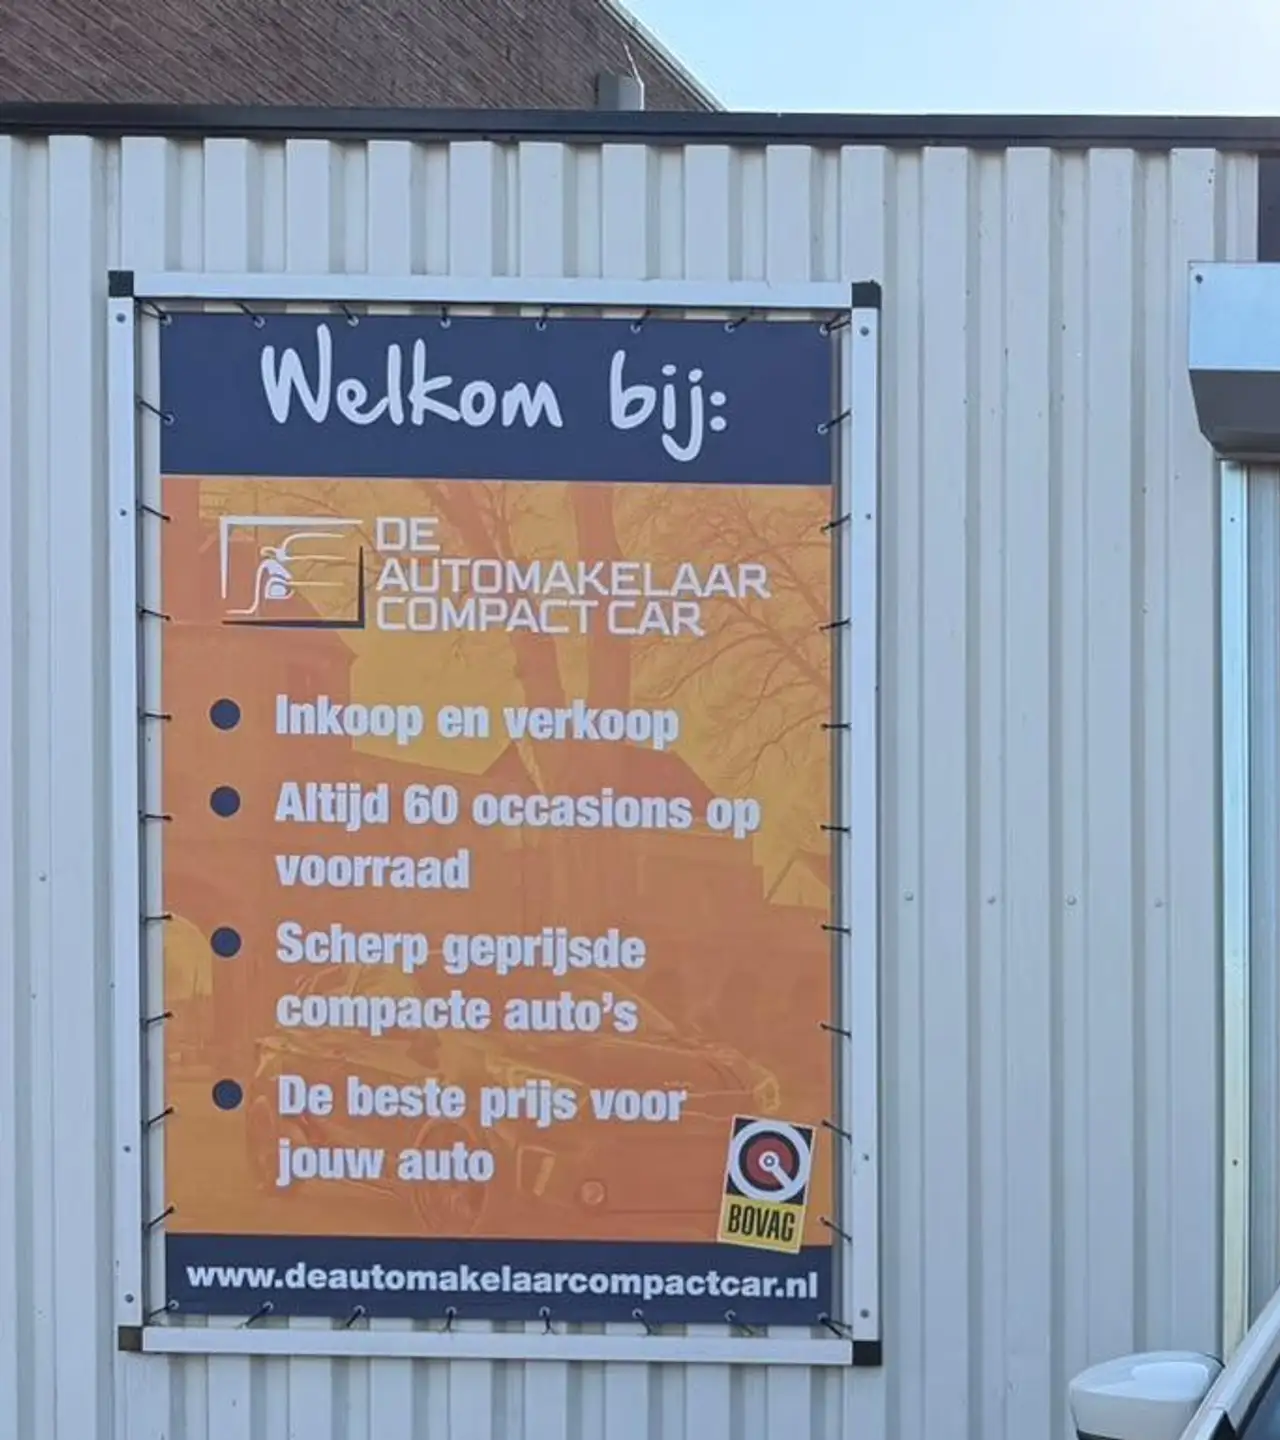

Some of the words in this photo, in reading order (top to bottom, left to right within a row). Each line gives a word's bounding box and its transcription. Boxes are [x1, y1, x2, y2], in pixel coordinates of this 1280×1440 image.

[260, 324, 563, 427] Welkom
[610, 350, 727, 462] bij:
[376, 517, 440, 552] DE
[376, 559, 770, 599] AUTOMAKELAAR
[376, 601, 599, 634] COMPACT
[607, 603, 705, 637] CAR
[276, 693, 424, 746] Inkoop
[437, 705, 490, 738] en
[503, 699, 680, 751] verkoop
[275, 781, 390, 832] Altijd
[403, 784, 459, 825] 60
[472, 787, 693, 829] occasions
[705, 797, 761, 839] op
[275, 848, 470, 889] voorraad
[276, 921, 430, 974] Scherp
[441, 927, 647, 977] geprijsde
[276, 989, 491, 1037] compacte
[503, 991, 638, 1033] auto's
[278, 1074, 333, 1116] De
[346, 1075, 466, 1119] beste
[480, 1079, 578, 1128] prijs
[590, 1088, 688, 1122] voor
[276, 1138, 385, 1187] jouw
[397, 1141, 495, 1182] auto
[727, 1203, 796, 1244] BOVAG
[186, 1263, 818, 1300] www.deautomakelaarcompactcar.nl
